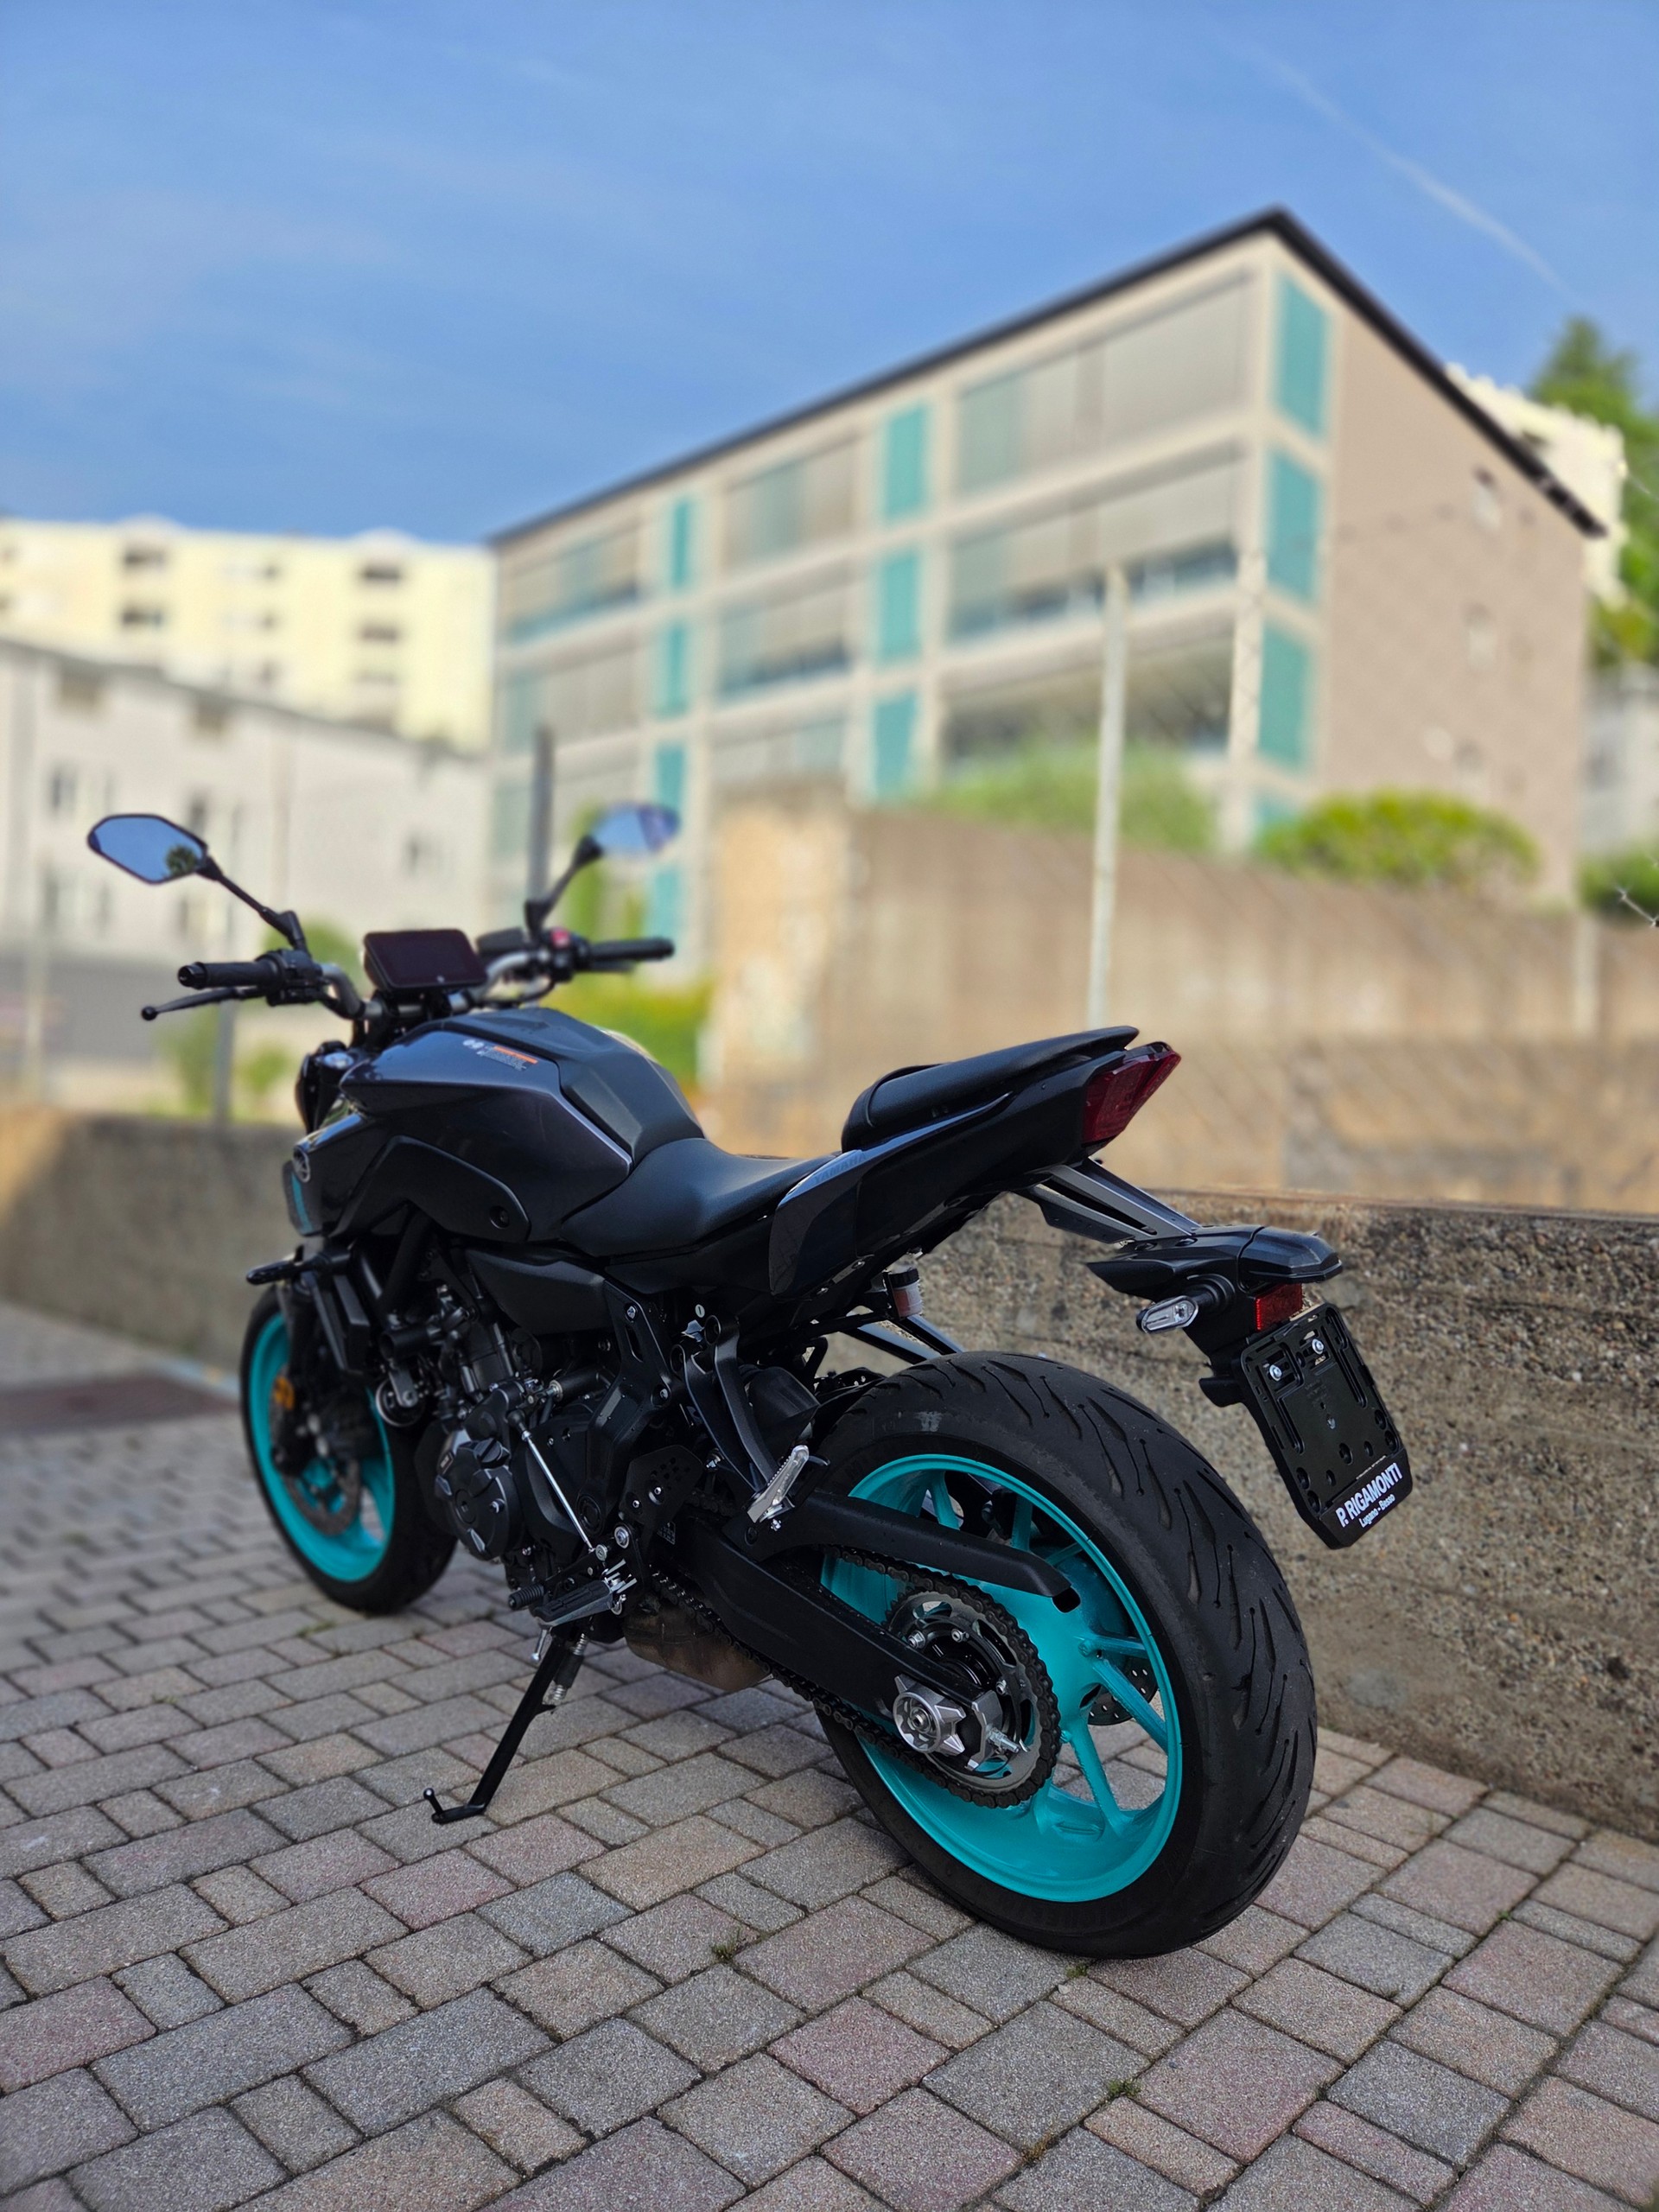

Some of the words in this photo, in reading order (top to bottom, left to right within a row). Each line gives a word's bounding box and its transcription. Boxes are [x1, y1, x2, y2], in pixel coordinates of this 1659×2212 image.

[814, 1152, 868, 1184] YAMAHA
[1344, 1462, 1403, 1520] RIGAMONTI
[1358, 1508, 1379, 1528] Lugano
[1378, 1494, 1395, 1510] Besso
